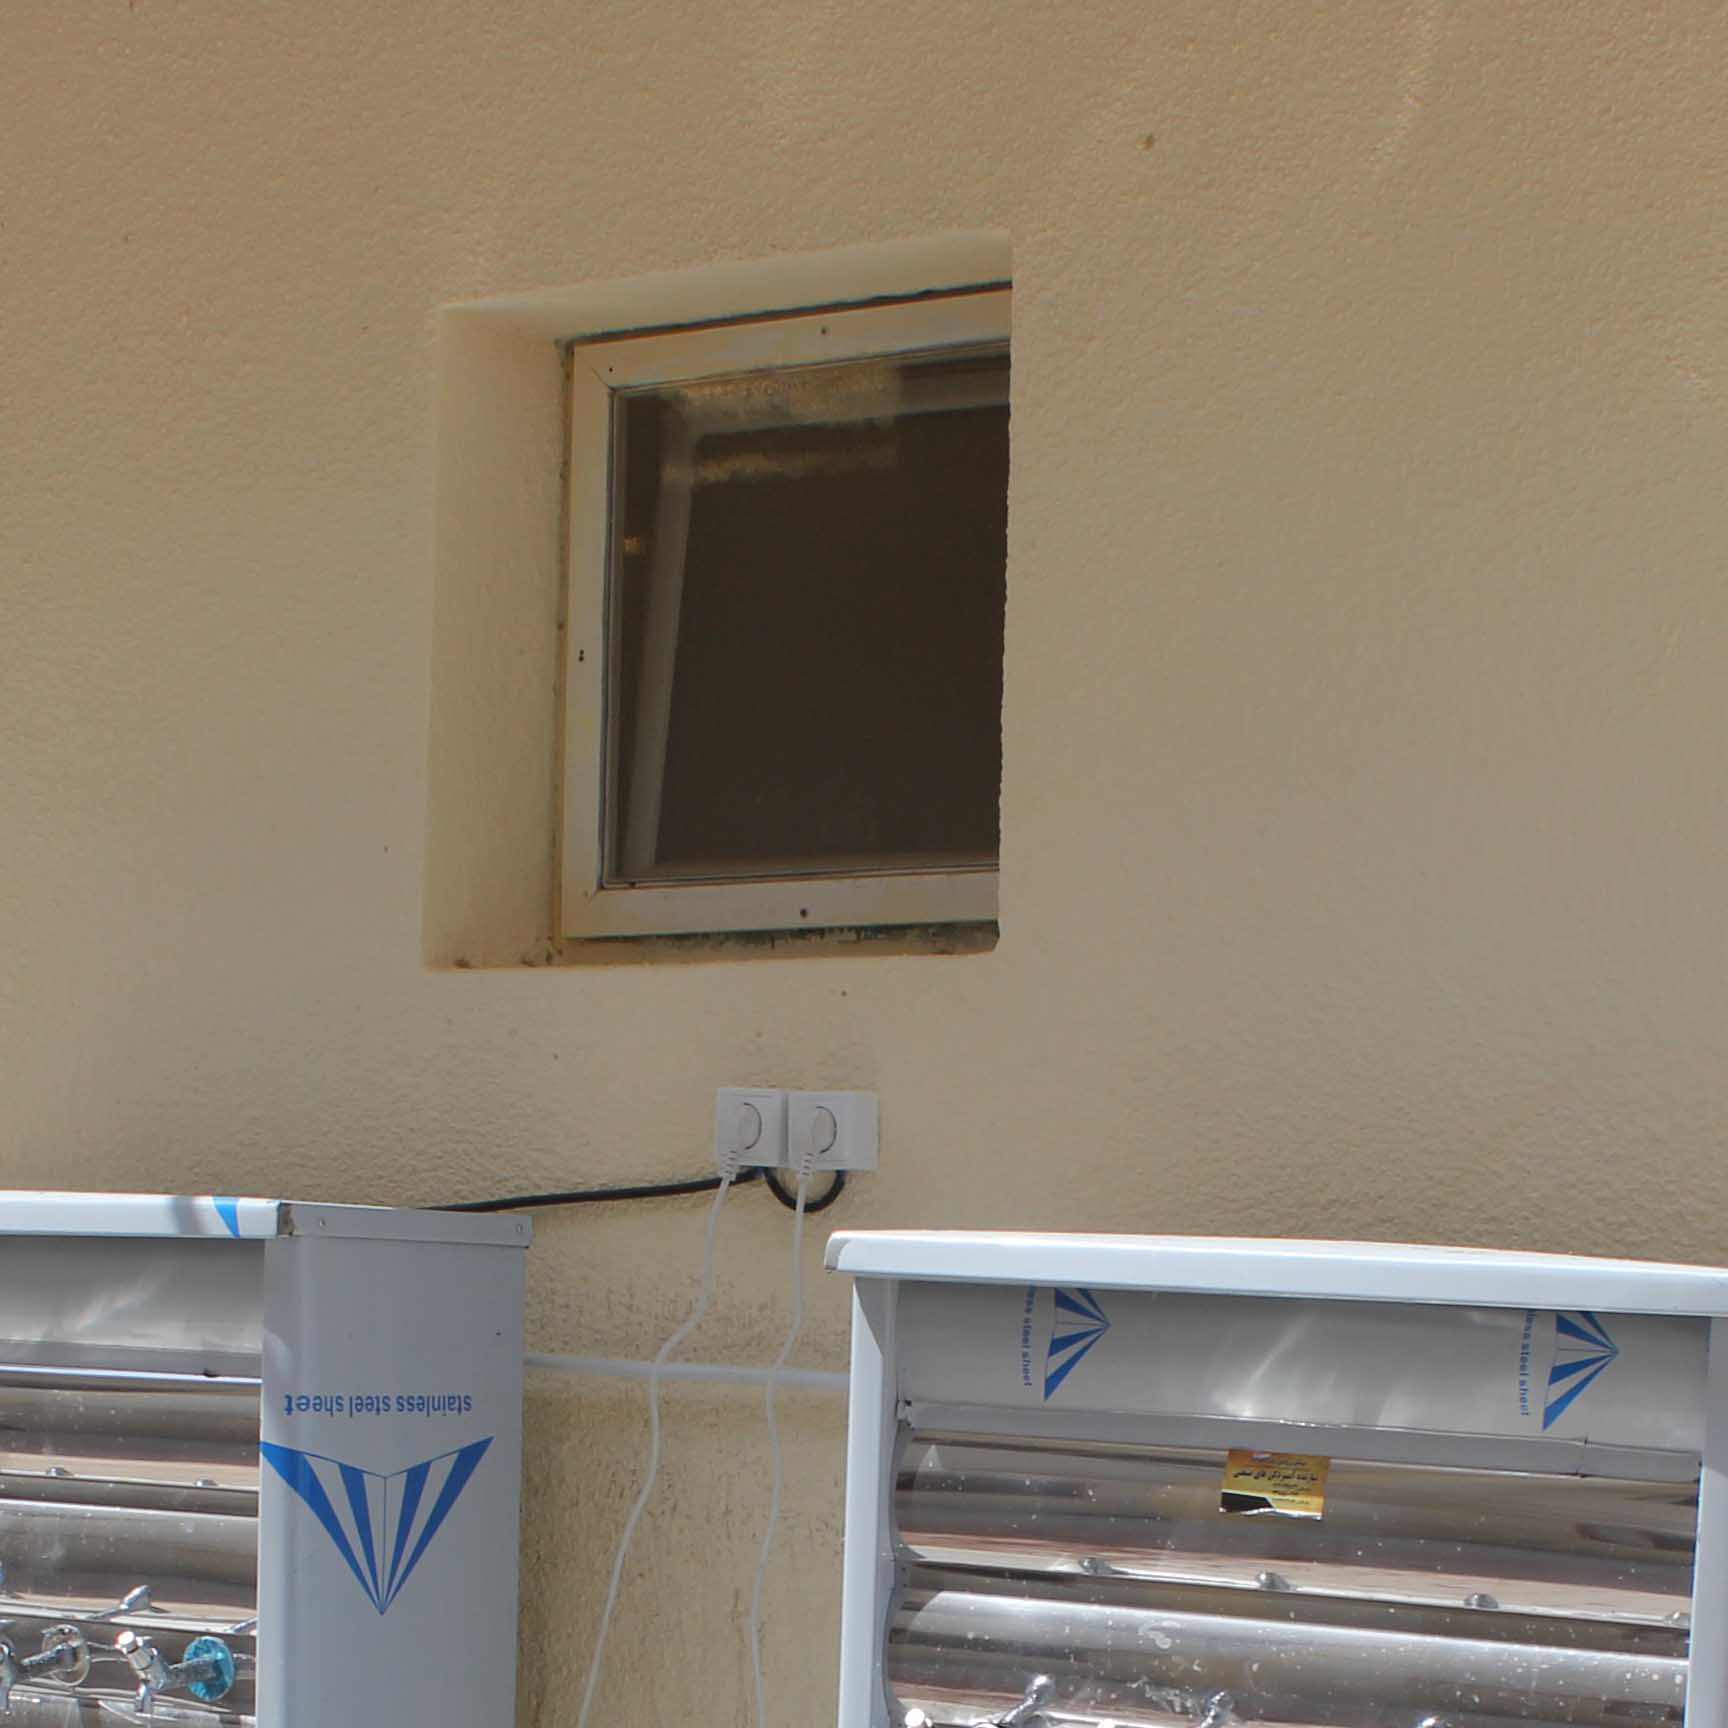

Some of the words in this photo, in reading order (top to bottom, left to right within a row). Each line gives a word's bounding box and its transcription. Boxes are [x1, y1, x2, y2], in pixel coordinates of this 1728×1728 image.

[283, 1393, 345, 1418] sheet
[349, 1394, 392, 1418] steel
[394, 1394, 473, 1418] stainless
